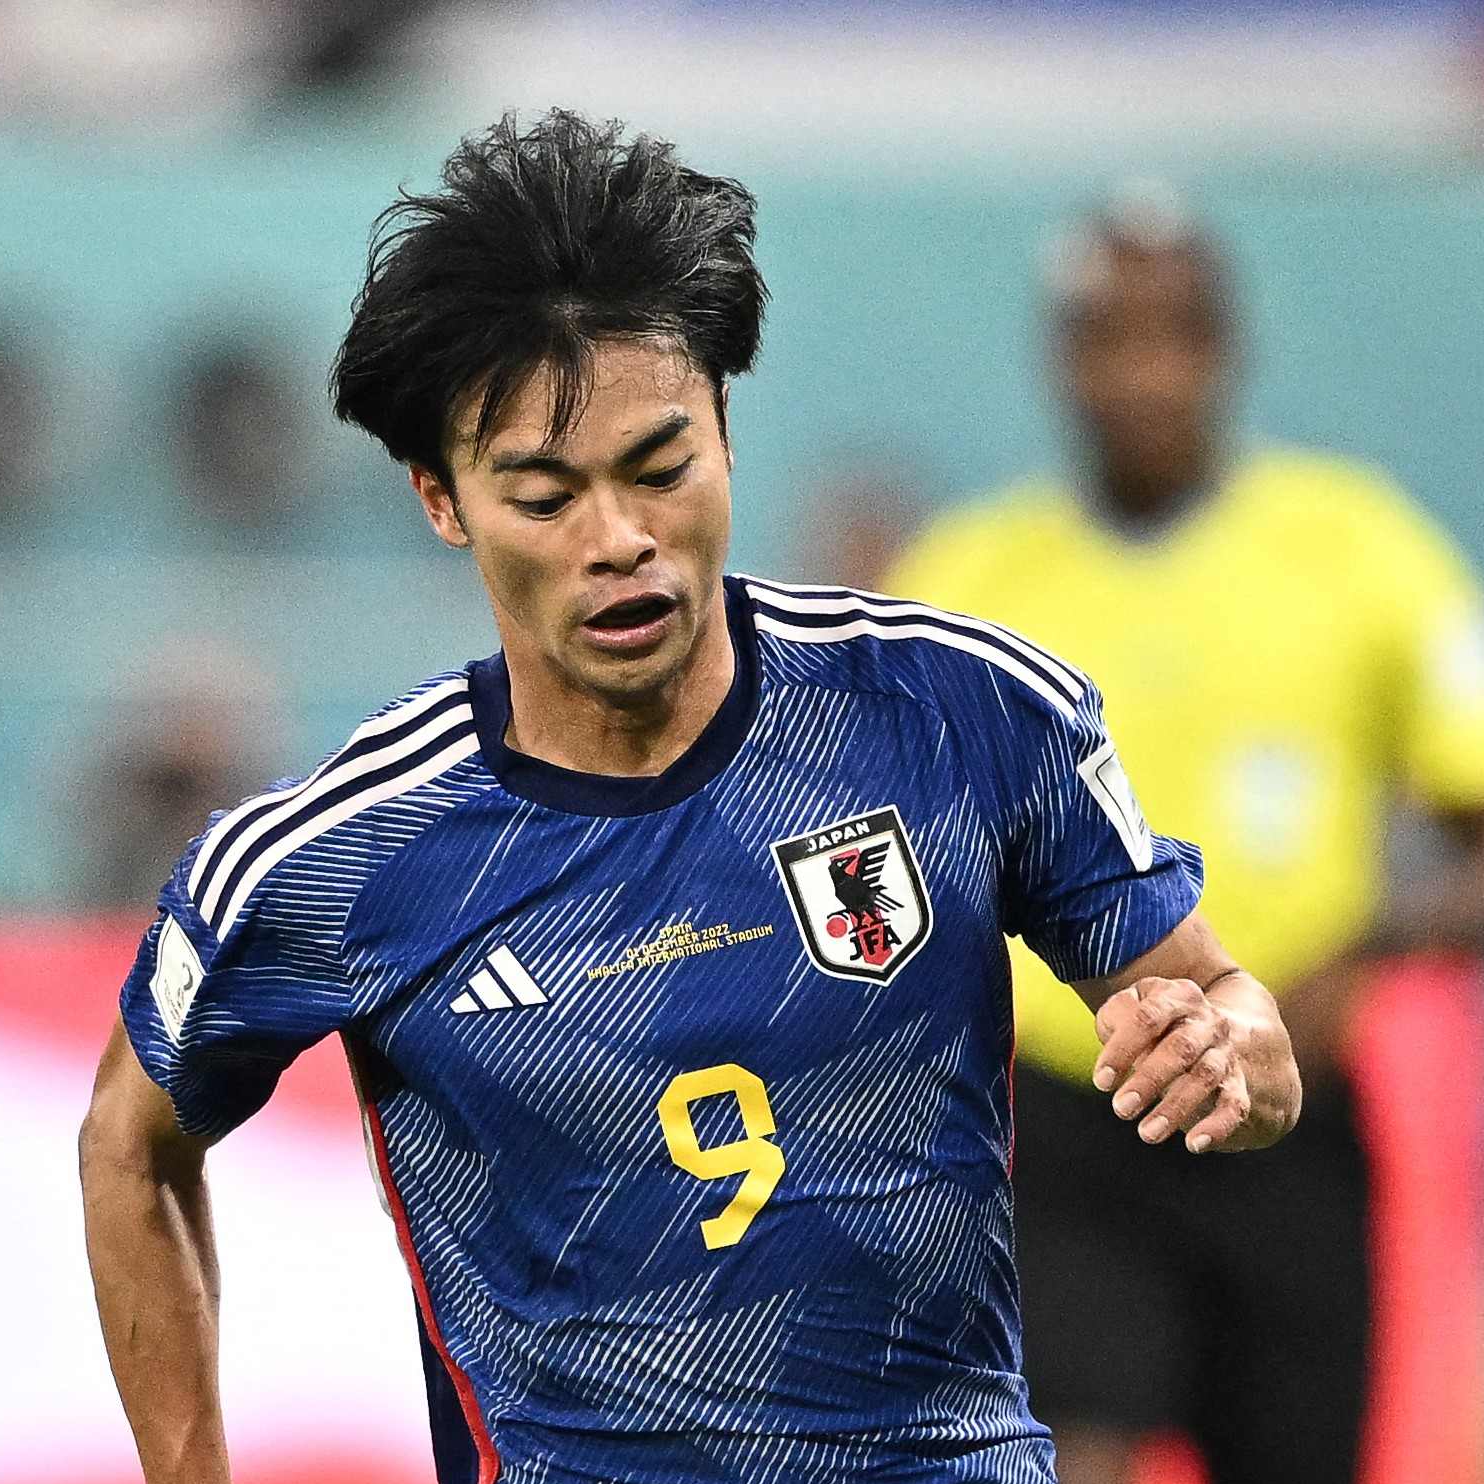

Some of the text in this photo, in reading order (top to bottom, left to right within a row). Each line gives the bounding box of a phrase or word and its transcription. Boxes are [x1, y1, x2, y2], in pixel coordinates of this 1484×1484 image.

[805, 821, 871, 853] JAPAN
[642, 932, 700, 957] DECEMBER
[701, 923, 731, 940] 2022
[659, 921, 693, 939] SPAIN
[849, 924, 902, 961] JFA
[587, 924, 774, 980] KHALIFA INTERNATIONAL STADIUM
[657, 1063, 786, 1251] 9
